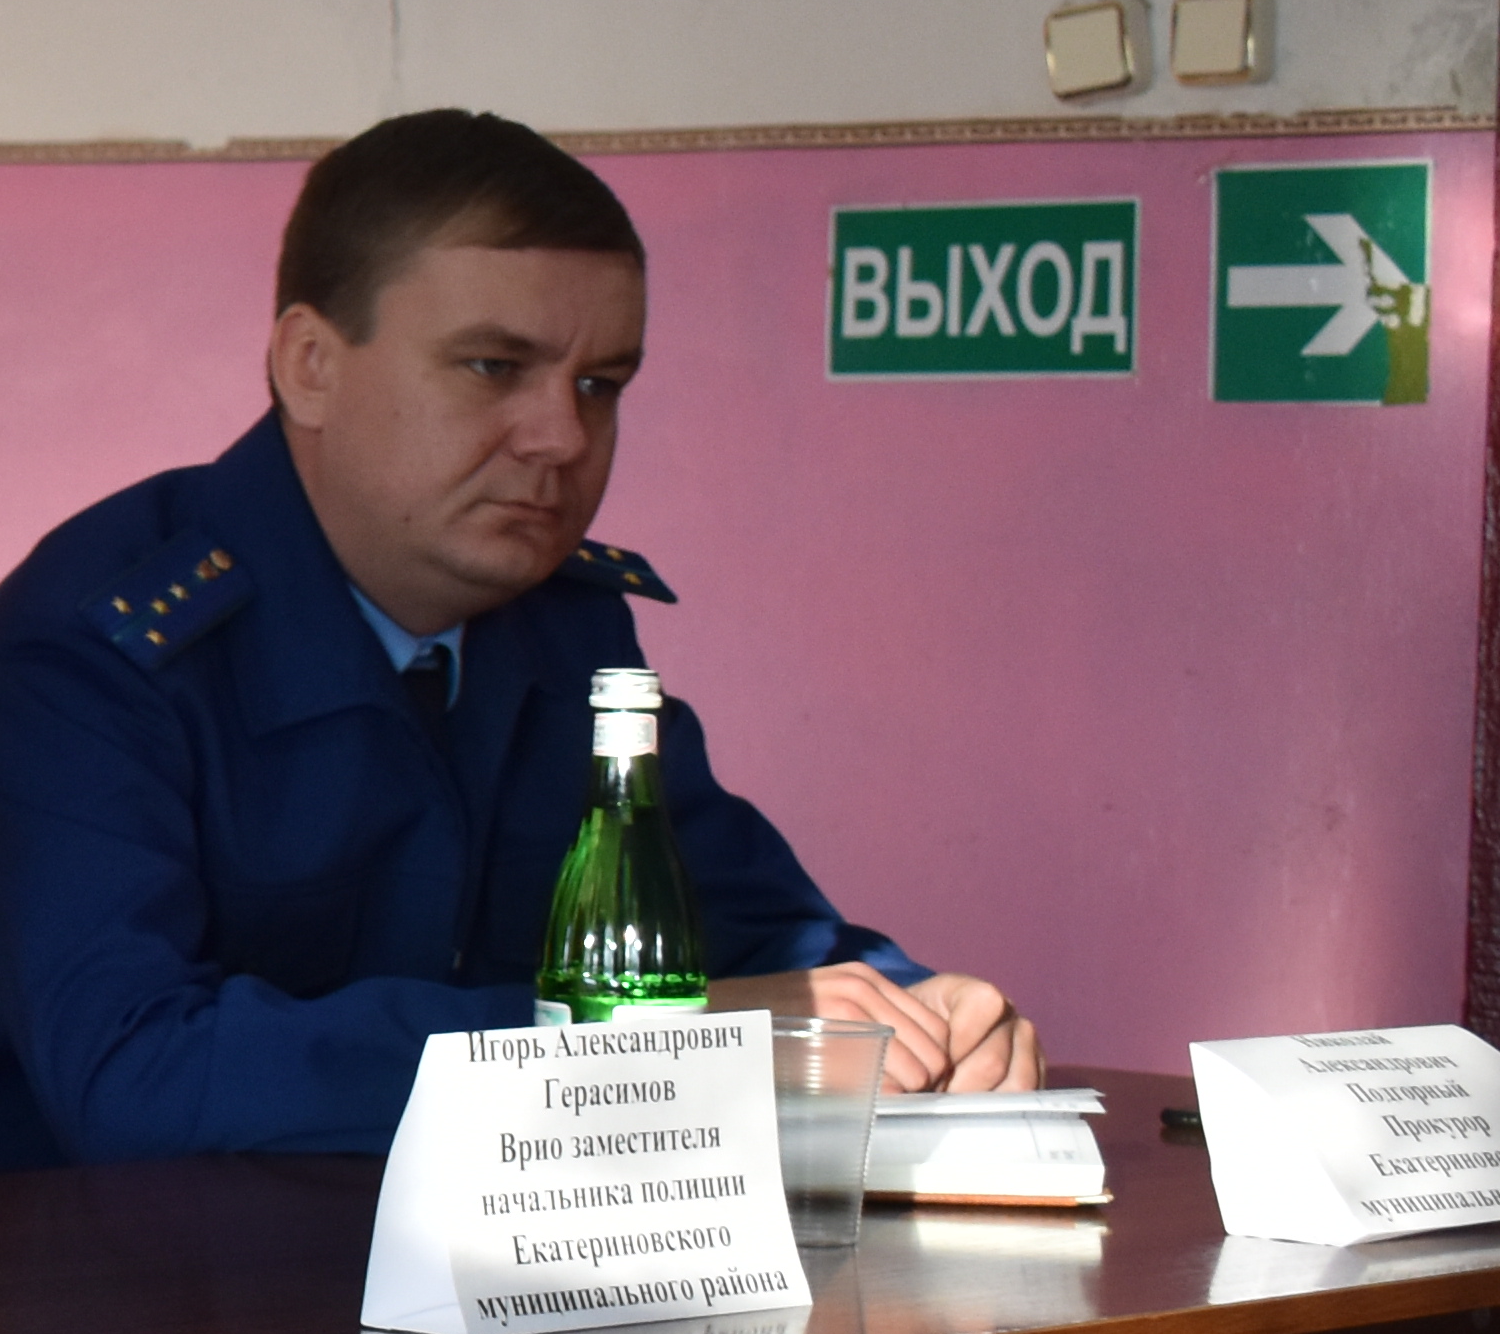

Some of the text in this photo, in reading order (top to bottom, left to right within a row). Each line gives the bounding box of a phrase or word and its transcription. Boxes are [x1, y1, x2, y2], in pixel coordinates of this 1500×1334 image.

[842, 240, 1127, 354] ВЫХОД
[467, 1024, 745, 1068] Игорь Александрович
[1298, 1055, 1458, 1074] Александрович
[544, 1078, 676, 1115] Герасимов
[1345, 1079, 1470, 1105] Подгорный
[500, 1126, 721, 1170] Врио заместителя
[1382, 1114, 1491, 1142] Прокурор
[481, 1174, 747, 1216] начальника полиции
[512, 1225, 732, 1268] Екатериновского
[475, 1267, 789, 1327] муниципального района
